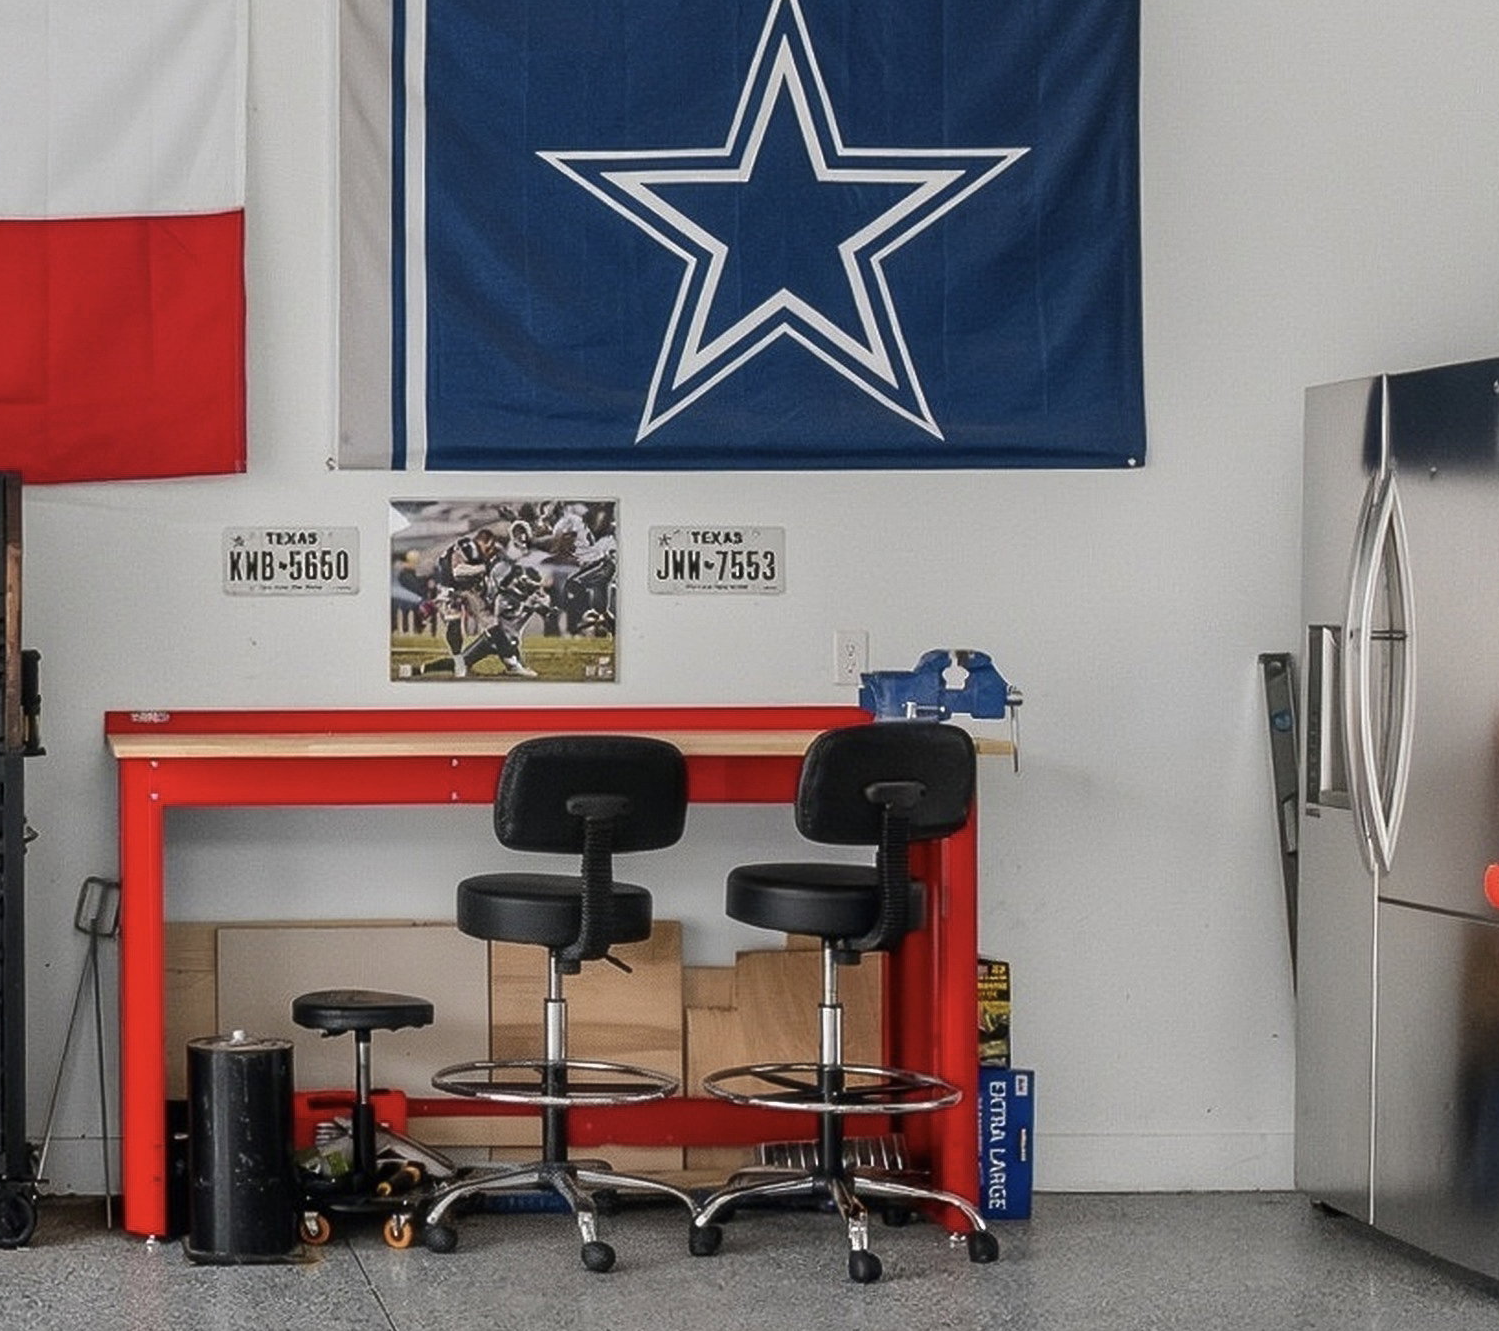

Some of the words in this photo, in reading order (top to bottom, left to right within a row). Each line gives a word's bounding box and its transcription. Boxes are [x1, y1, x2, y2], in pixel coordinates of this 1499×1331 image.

[266, 531, 318, 545] TEXAS
[691, 530, 743, 545] TEXAS
[988, 1080, 1007, 1142] EXTRA
[988, 1148, 1007, 1210] LARGE
